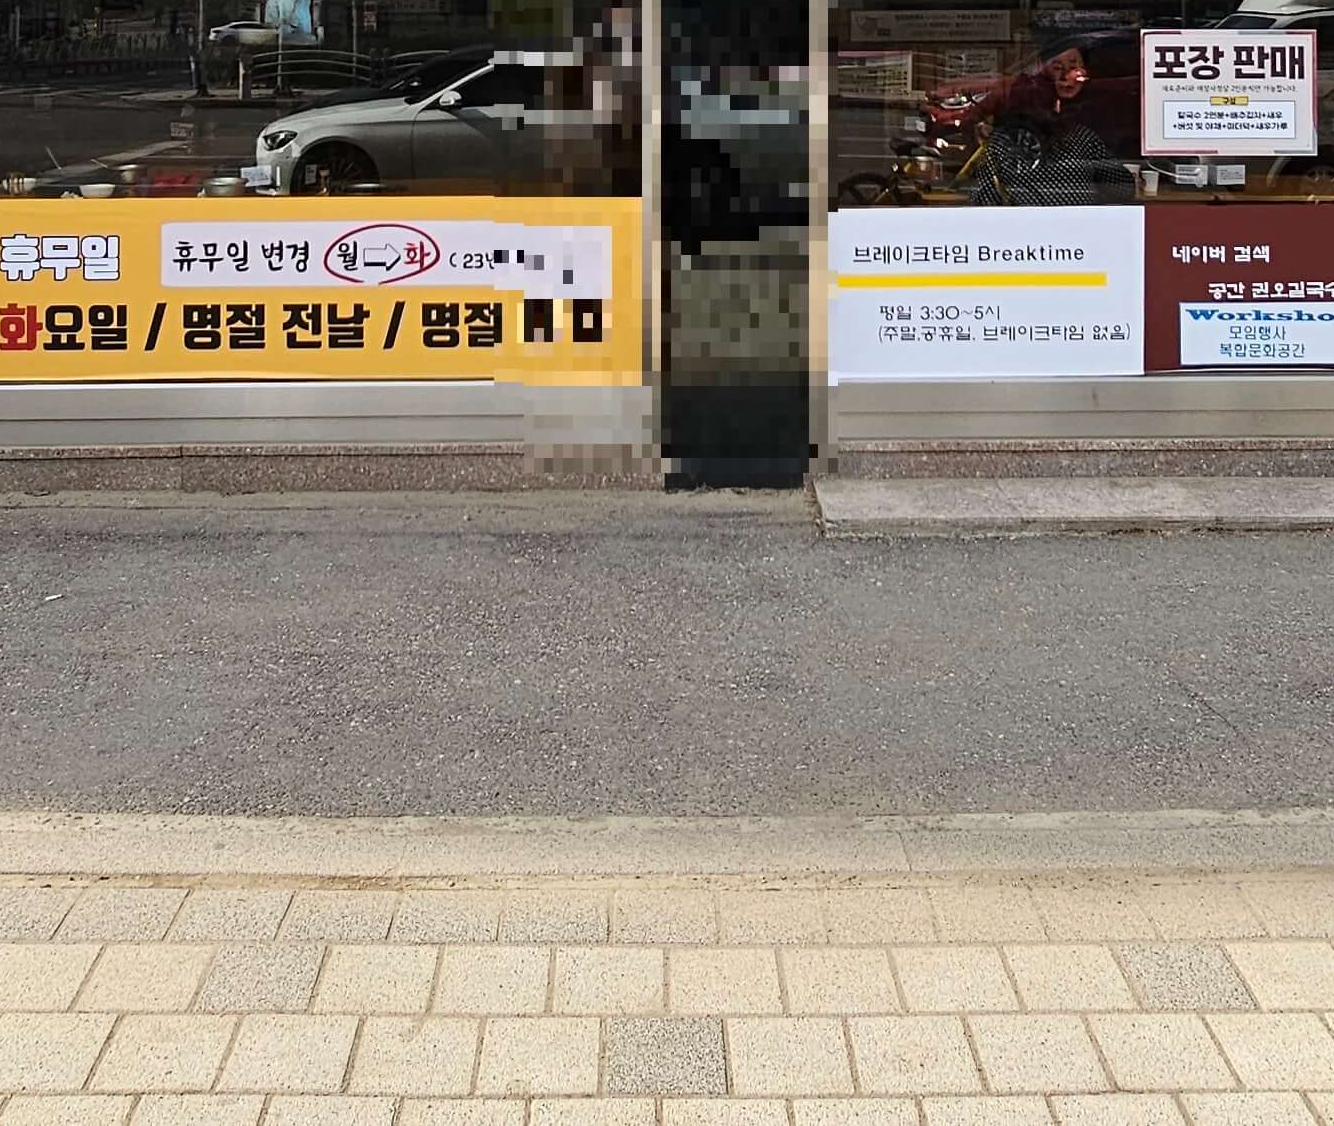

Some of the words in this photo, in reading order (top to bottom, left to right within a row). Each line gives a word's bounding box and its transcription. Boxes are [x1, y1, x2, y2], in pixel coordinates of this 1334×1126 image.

[1153, 45, 1225, 80] 포장
[1233, 45, 1305, 80] 판매
[171, 240, 250, 273] 휴무일
[260, 240, 310, 273] 변경
[337, 240, 359, 272] 월
[403, 240, 431, 272] 화
[853, 243, 971, 264] 브레이크타임
[978, 244, 1085, 263] Breaktime
[1172, 245, 1226, 264] 네이버
[1233, 245, 1271, 264] 검색
[1208, 282, 1246, 299] 공간
[879, 305, 912, 321] 평일
[182, 302, 266, 351] 명절
[281, 302, 370, 350] 전날
[421, 302, 503, 350] 명절
[982, 324, 1084, 342] 브레이크타임
[1228, 325, 1287, 341] 모임행사
[1219, 342, 1306, 358] 복합문화공간
